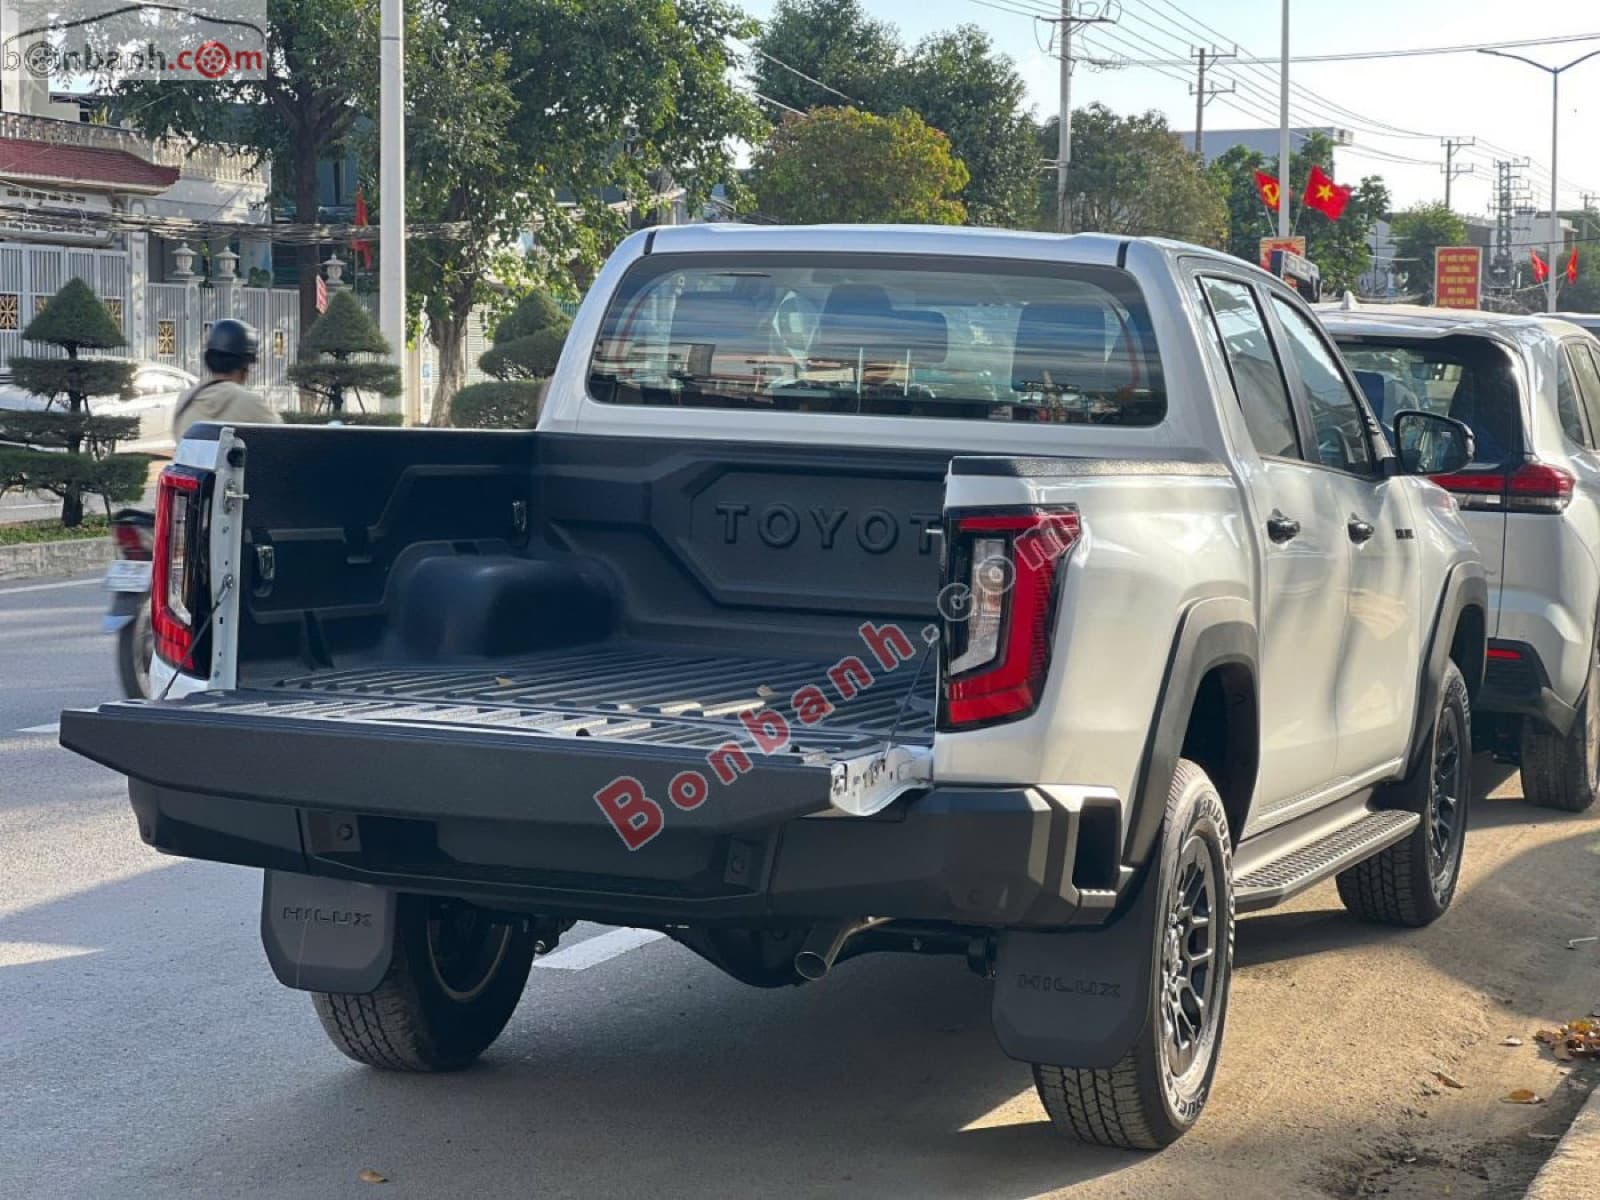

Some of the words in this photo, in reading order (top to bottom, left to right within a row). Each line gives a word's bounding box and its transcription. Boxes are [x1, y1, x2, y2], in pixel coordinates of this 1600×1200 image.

[715, 502, 943, 555] TOYOT
[283, 905, 373, 927] HILUX
[1016, 973, 1121, 999] HILUX
